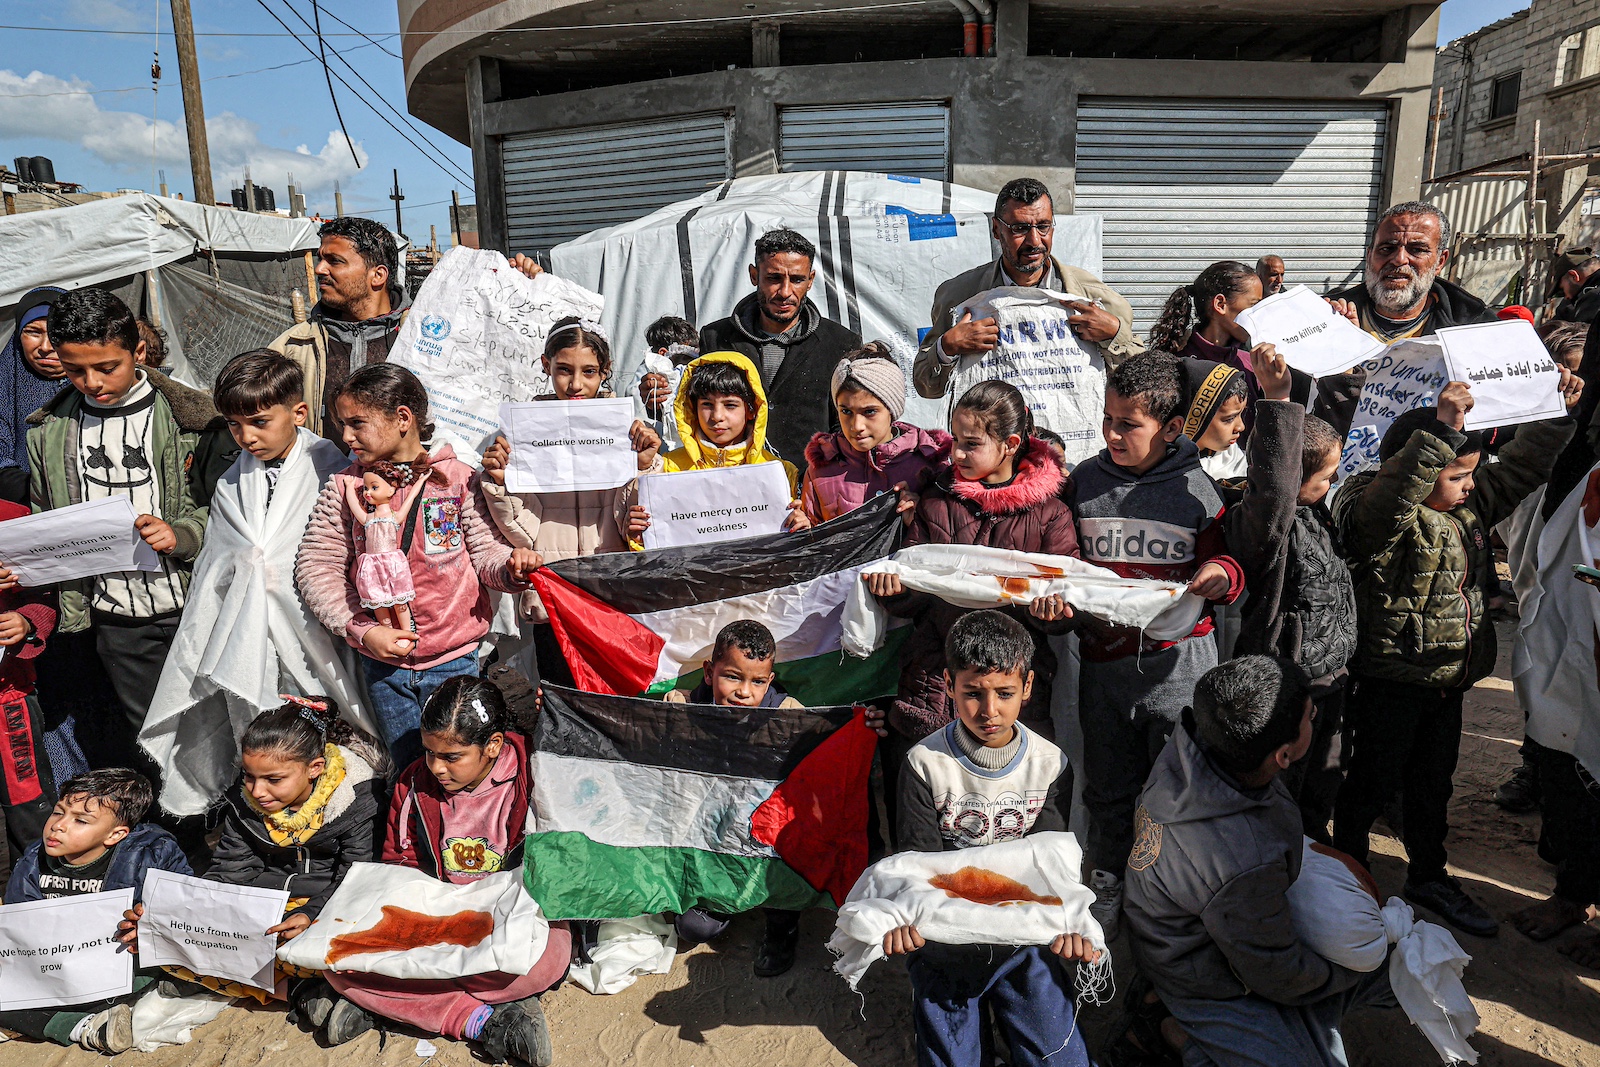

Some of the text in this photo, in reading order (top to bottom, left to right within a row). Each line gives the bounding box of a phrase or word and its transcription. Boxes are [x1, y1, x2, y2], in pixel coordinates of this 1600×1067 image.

[998, 317, 1073, 347] NRW
[1298, 326, 1323, 339] killing
[415, 337, 443, 352] unrwa
[455, 328, 497, 357] Stop
[1021, 366, 1072, 377] DISTRIBUTION
[1073, 365, 1083, 373] TO
[1466, 359, 1555, 385] هذه إبادة جماعية
[1364, 382, 1415, 404] nsider
[531, 436, 615, 447] Collective worship
[671, 504, 769, 521] Have mercy on our
[697, 521, 748, 535] weakness
[29, 544, 56, 555] Help
[71, 537, 98, 547] from
[1081, 529, 1187, 560] adidas
[54, 545, 112, 560] occupation
[170, 919, 250, 941] Help us from the
[0, 948, 16, 958] We
[17, 947, 37, 958] hope
[38, 947, 49, 956] to
[51, 943, 75, 957] play
[184, 938, 238, 952] occupation
[40, 962, 63, 974] grow
